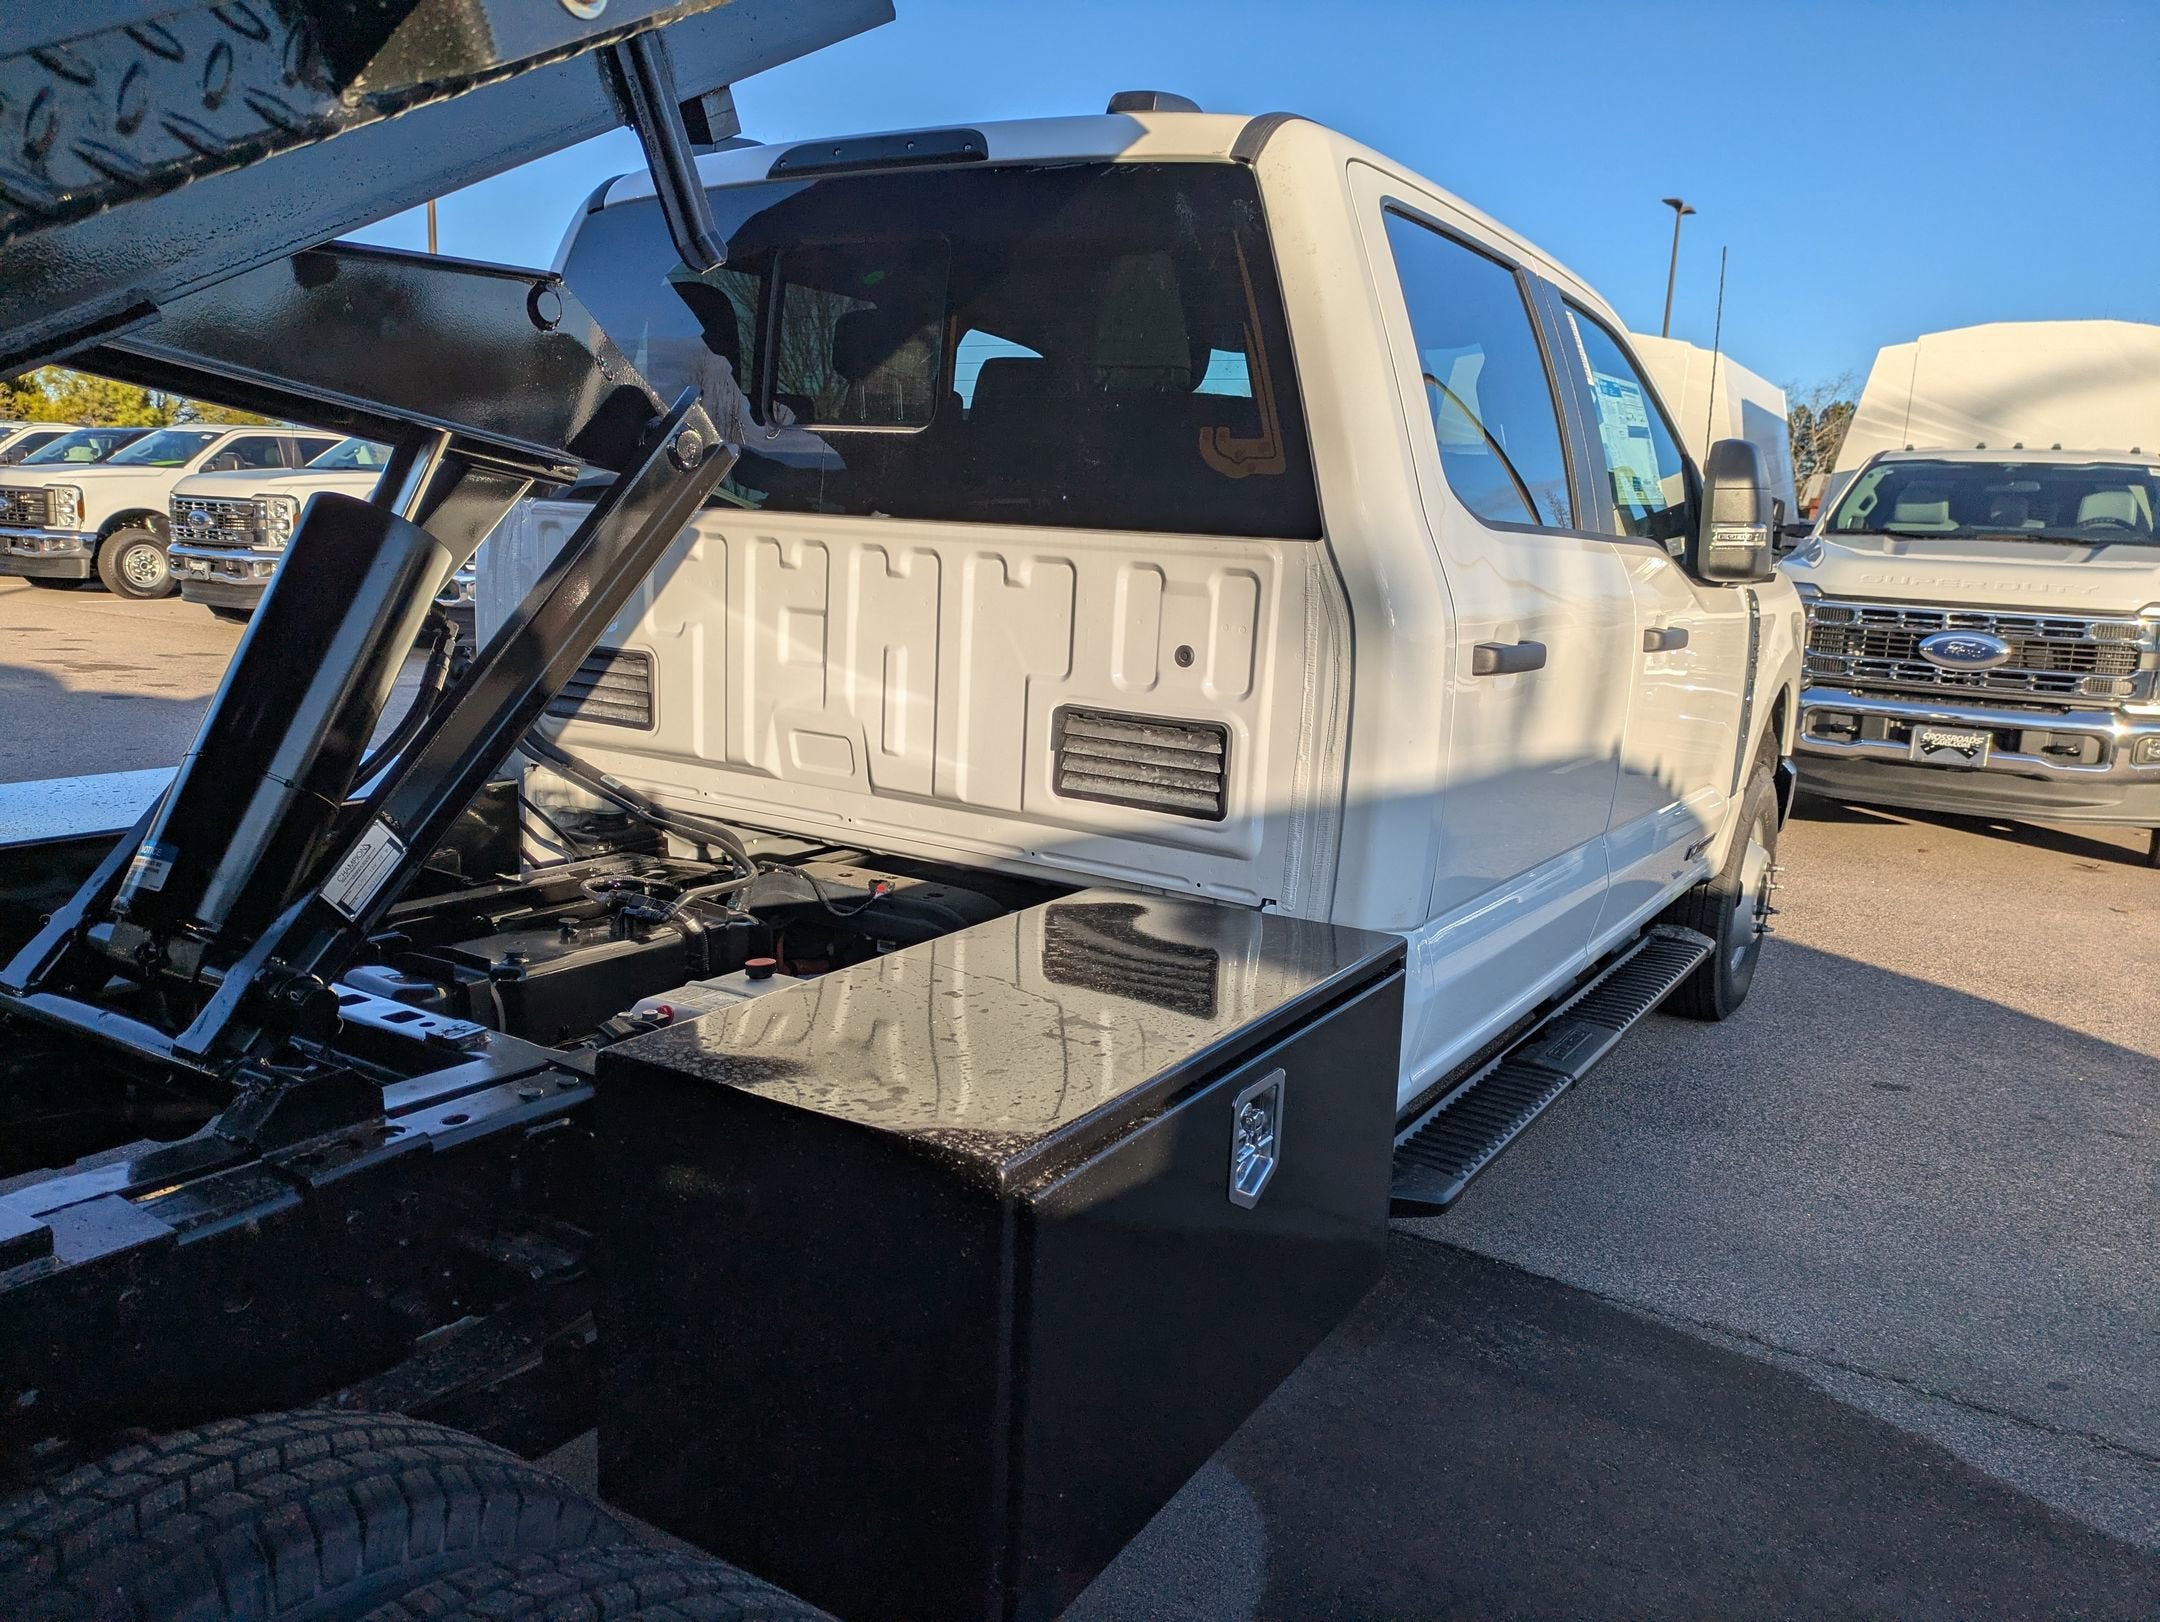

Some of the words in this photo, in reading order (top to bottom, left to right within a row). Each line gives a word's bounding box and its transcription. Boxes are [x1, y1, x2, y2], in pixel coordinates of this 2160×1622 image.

[1860, 574, 1987, 588] SUPER
[1993, 582, 2101, 594] DUTY
[1922, 732, 1984, 745] CROSSROADS
[336, 846, 371, 882] CHAMPION
